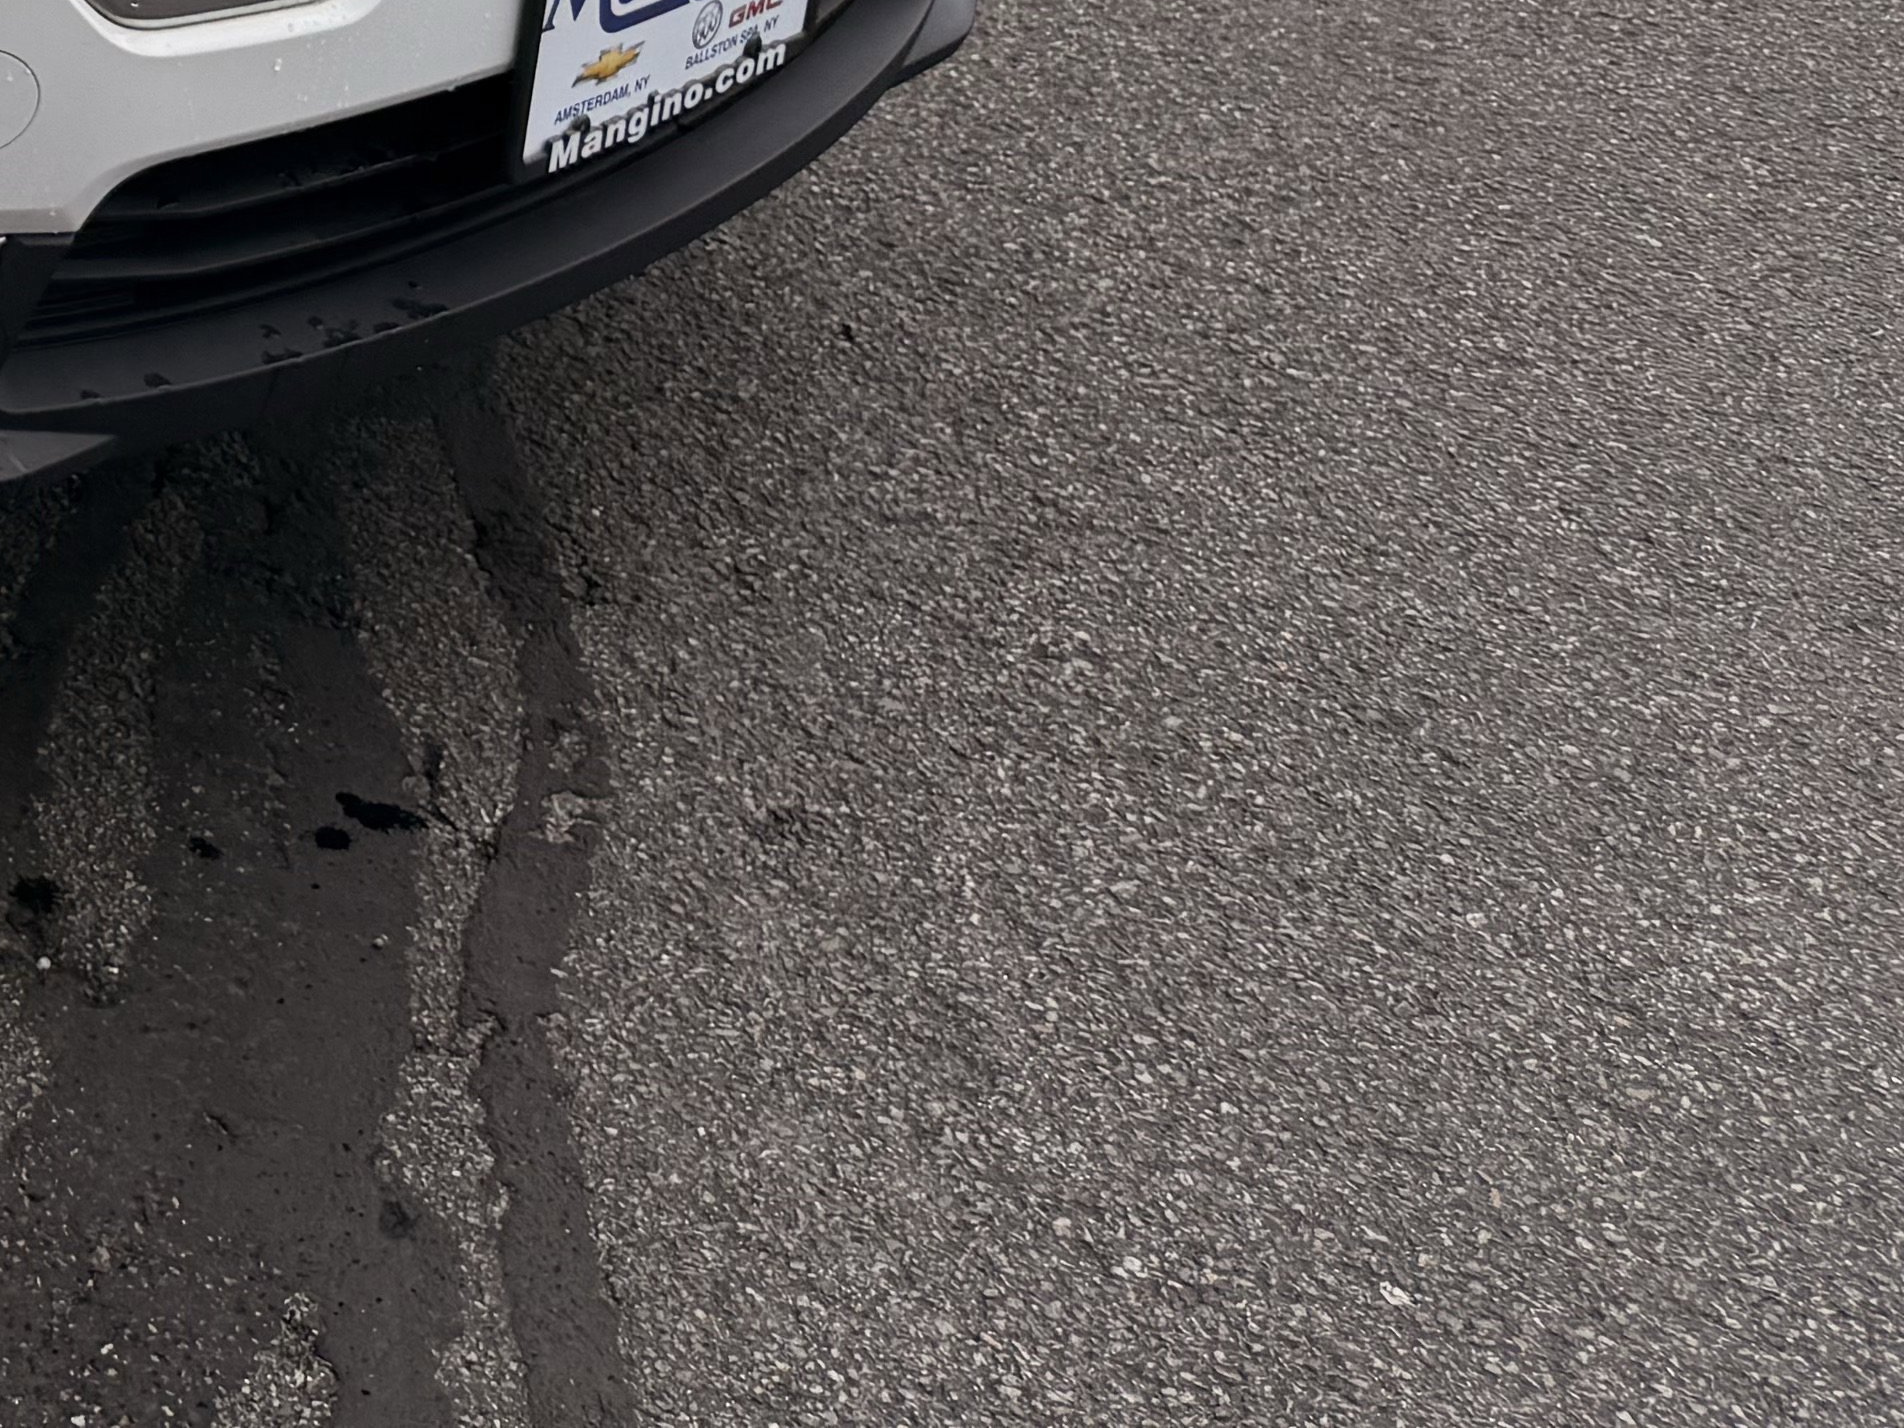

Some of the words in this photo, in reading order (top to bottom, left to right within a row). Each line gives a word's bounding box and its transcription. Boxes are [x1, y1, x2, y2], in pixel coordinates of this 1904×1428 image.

[684, 34, 738, 70] BALLSTON
[763, 14, 780, 33] NY
[547, 42, 787, 174] Mangino.com
[634, 73, 652, 93] NY
